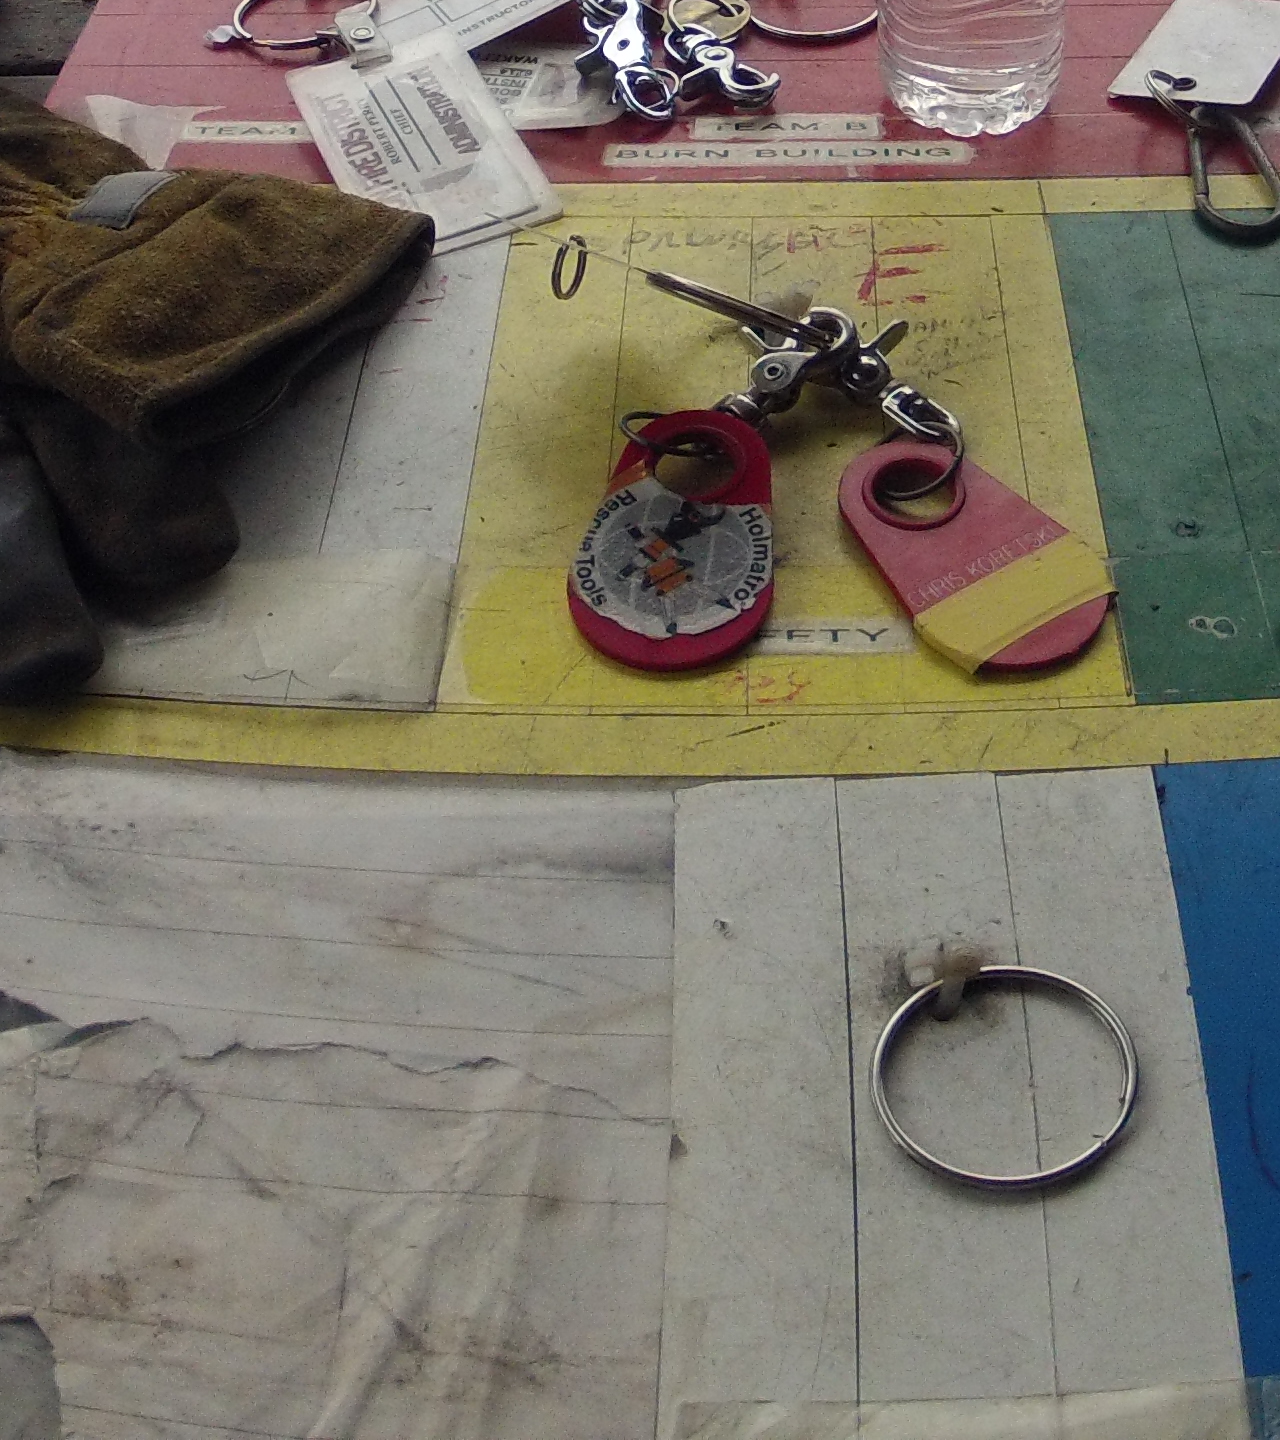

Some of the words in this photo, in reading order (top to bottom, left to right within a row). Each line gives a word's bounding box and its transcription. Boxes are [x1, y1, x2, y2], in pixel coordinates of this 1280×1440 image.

[389, 108, 414, 136] CHIEF
[406, 64, 482, 154] ADMINISTRATION
[713, 120, 821, 132] TEAM
[845, 120, 869, 131] B
[194, 126, 298, 135] TEAM
[372, 126, 403, 165] ROBERT
[615, 147, 731, 160] BURN
[754, 146, 953, 159] BUILDING
[578, 488, 638, 552] Rescue
[733, 506, 772, 603] Holmatro
[574, 557, 608, 608] Tools
[906, 570, 967, 608] CHRIS
